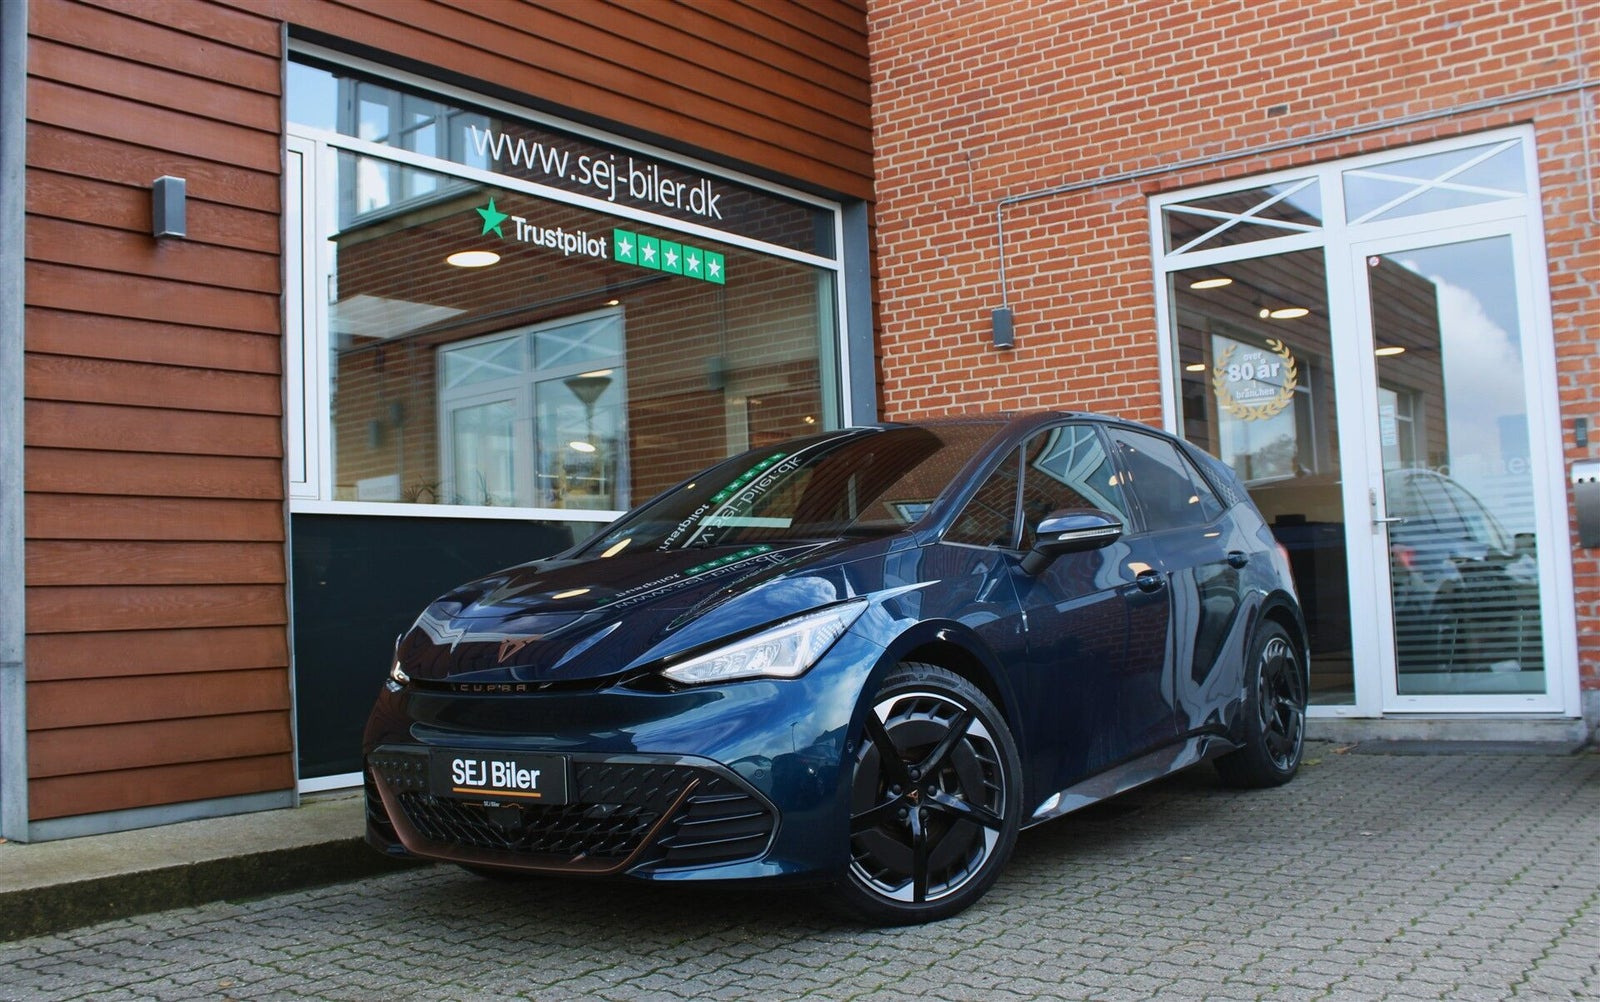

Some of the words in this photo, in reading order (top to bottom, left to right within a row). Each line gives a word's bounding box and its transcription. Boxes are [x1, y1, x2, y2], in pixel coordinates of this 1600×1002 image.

[471, 124, 722, 220] www.sej-biler.dk
[511, 215, 608, 259] Trustpilot
[1227, 362, 1255, 382] 80
[1257, 358, 1280, 378] år
[460, 683, 527, 693] CUPRA
[452, 758, 487, 786] SEJ
[491, 761, 541, 789] Biler
